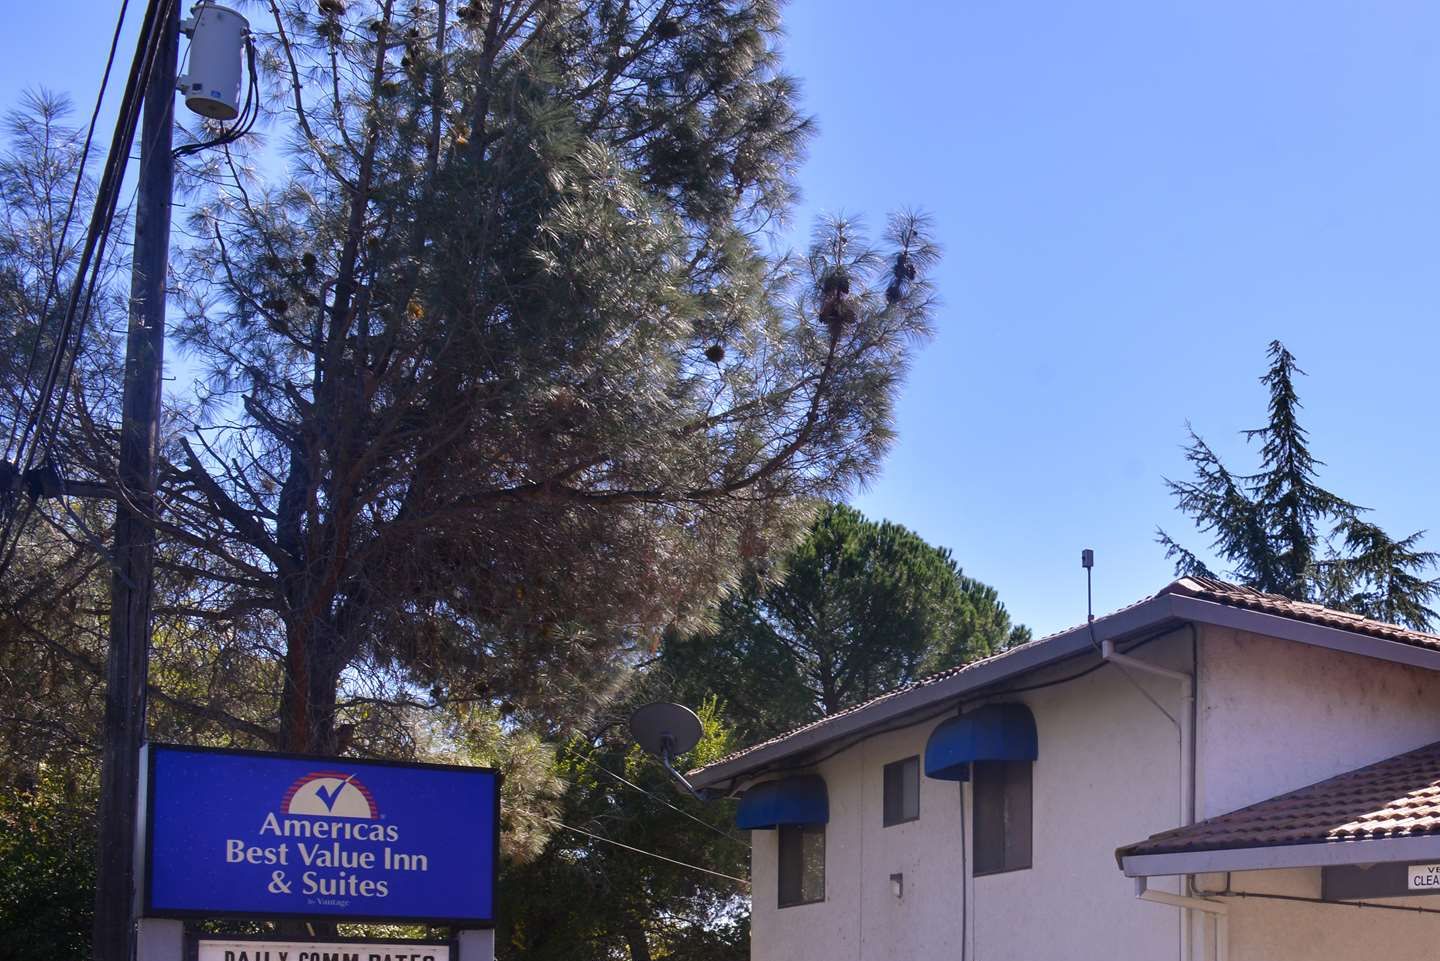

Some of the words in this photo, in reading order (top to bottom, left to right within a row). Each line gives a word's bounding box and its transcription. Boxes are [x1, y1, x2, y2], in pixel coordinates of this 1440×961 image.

[259, 812, 399, 842] Americas
[226, 839, 288, 866] Best
[297, 843, 375, 869] Value
[384, 847, 428, 871] Inn
[267, 870, 292, 894] &
[302, 871, 389, 897] Suites
